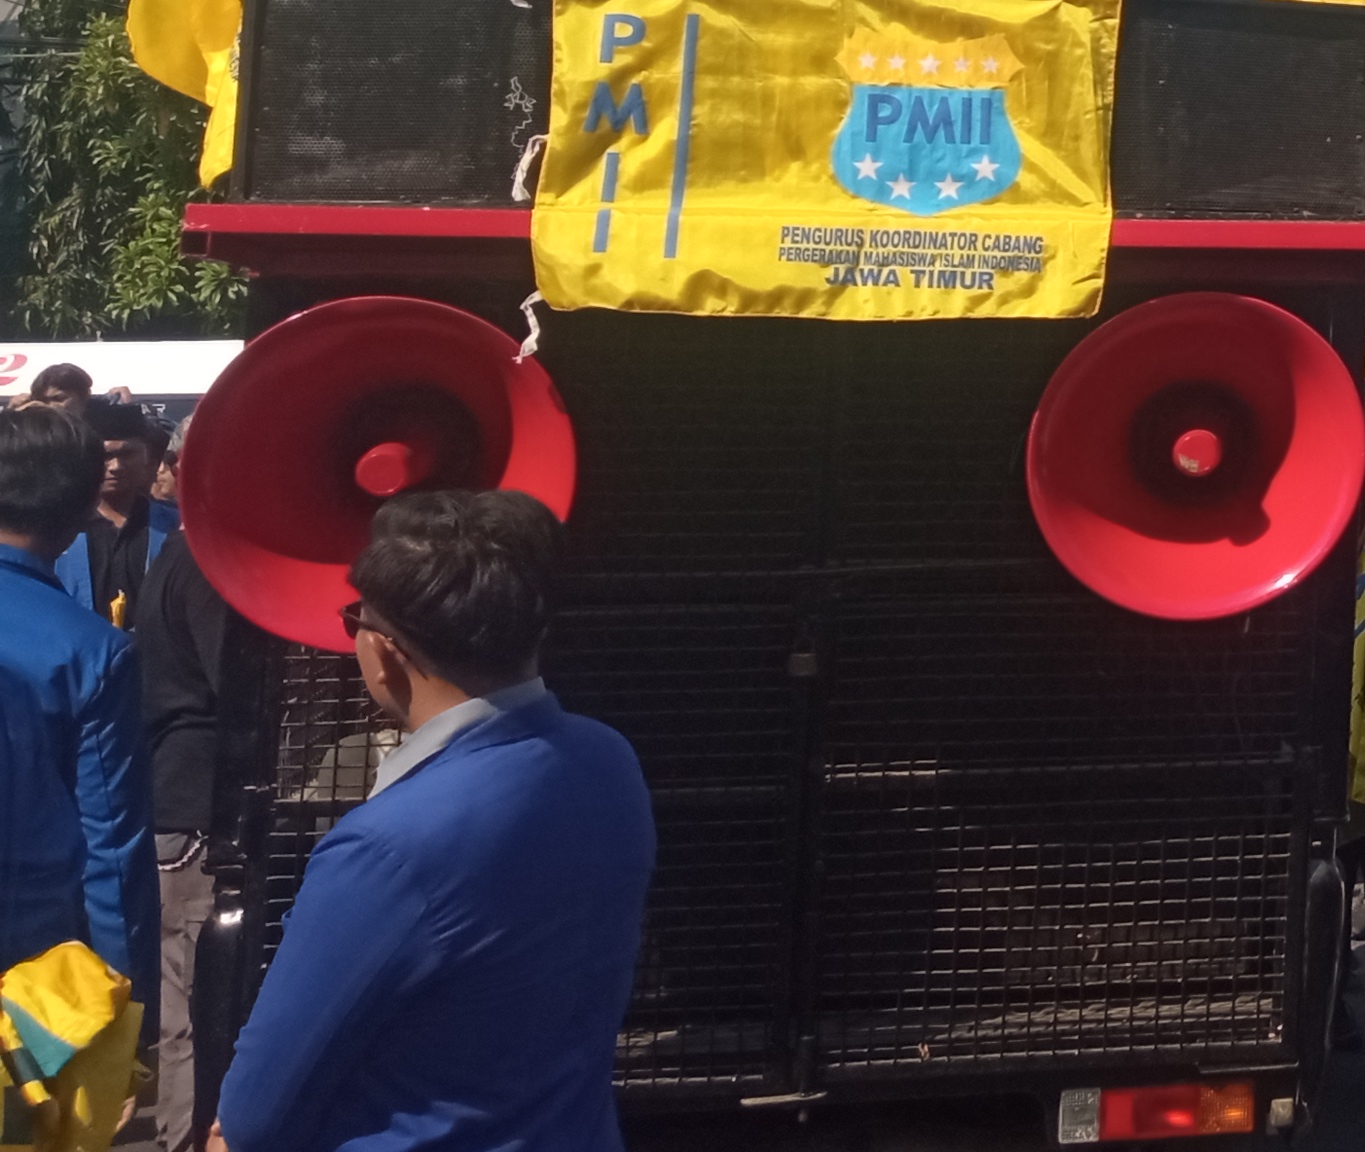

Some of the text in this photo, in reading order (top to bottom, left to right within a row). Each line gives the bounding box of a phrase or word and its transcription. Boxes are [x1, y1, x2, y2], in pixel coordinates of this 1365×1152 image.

[865, 93, 992, 145] PMII
[781, 226, 1044, 255] PENGURUS KOORDINATOR CABANG
[778, 246, 1042, 273] PERGERAKAN MAHASISWA ISLAM INDONESIA
[825, 266, 994, 290] JAWA TIMUR
